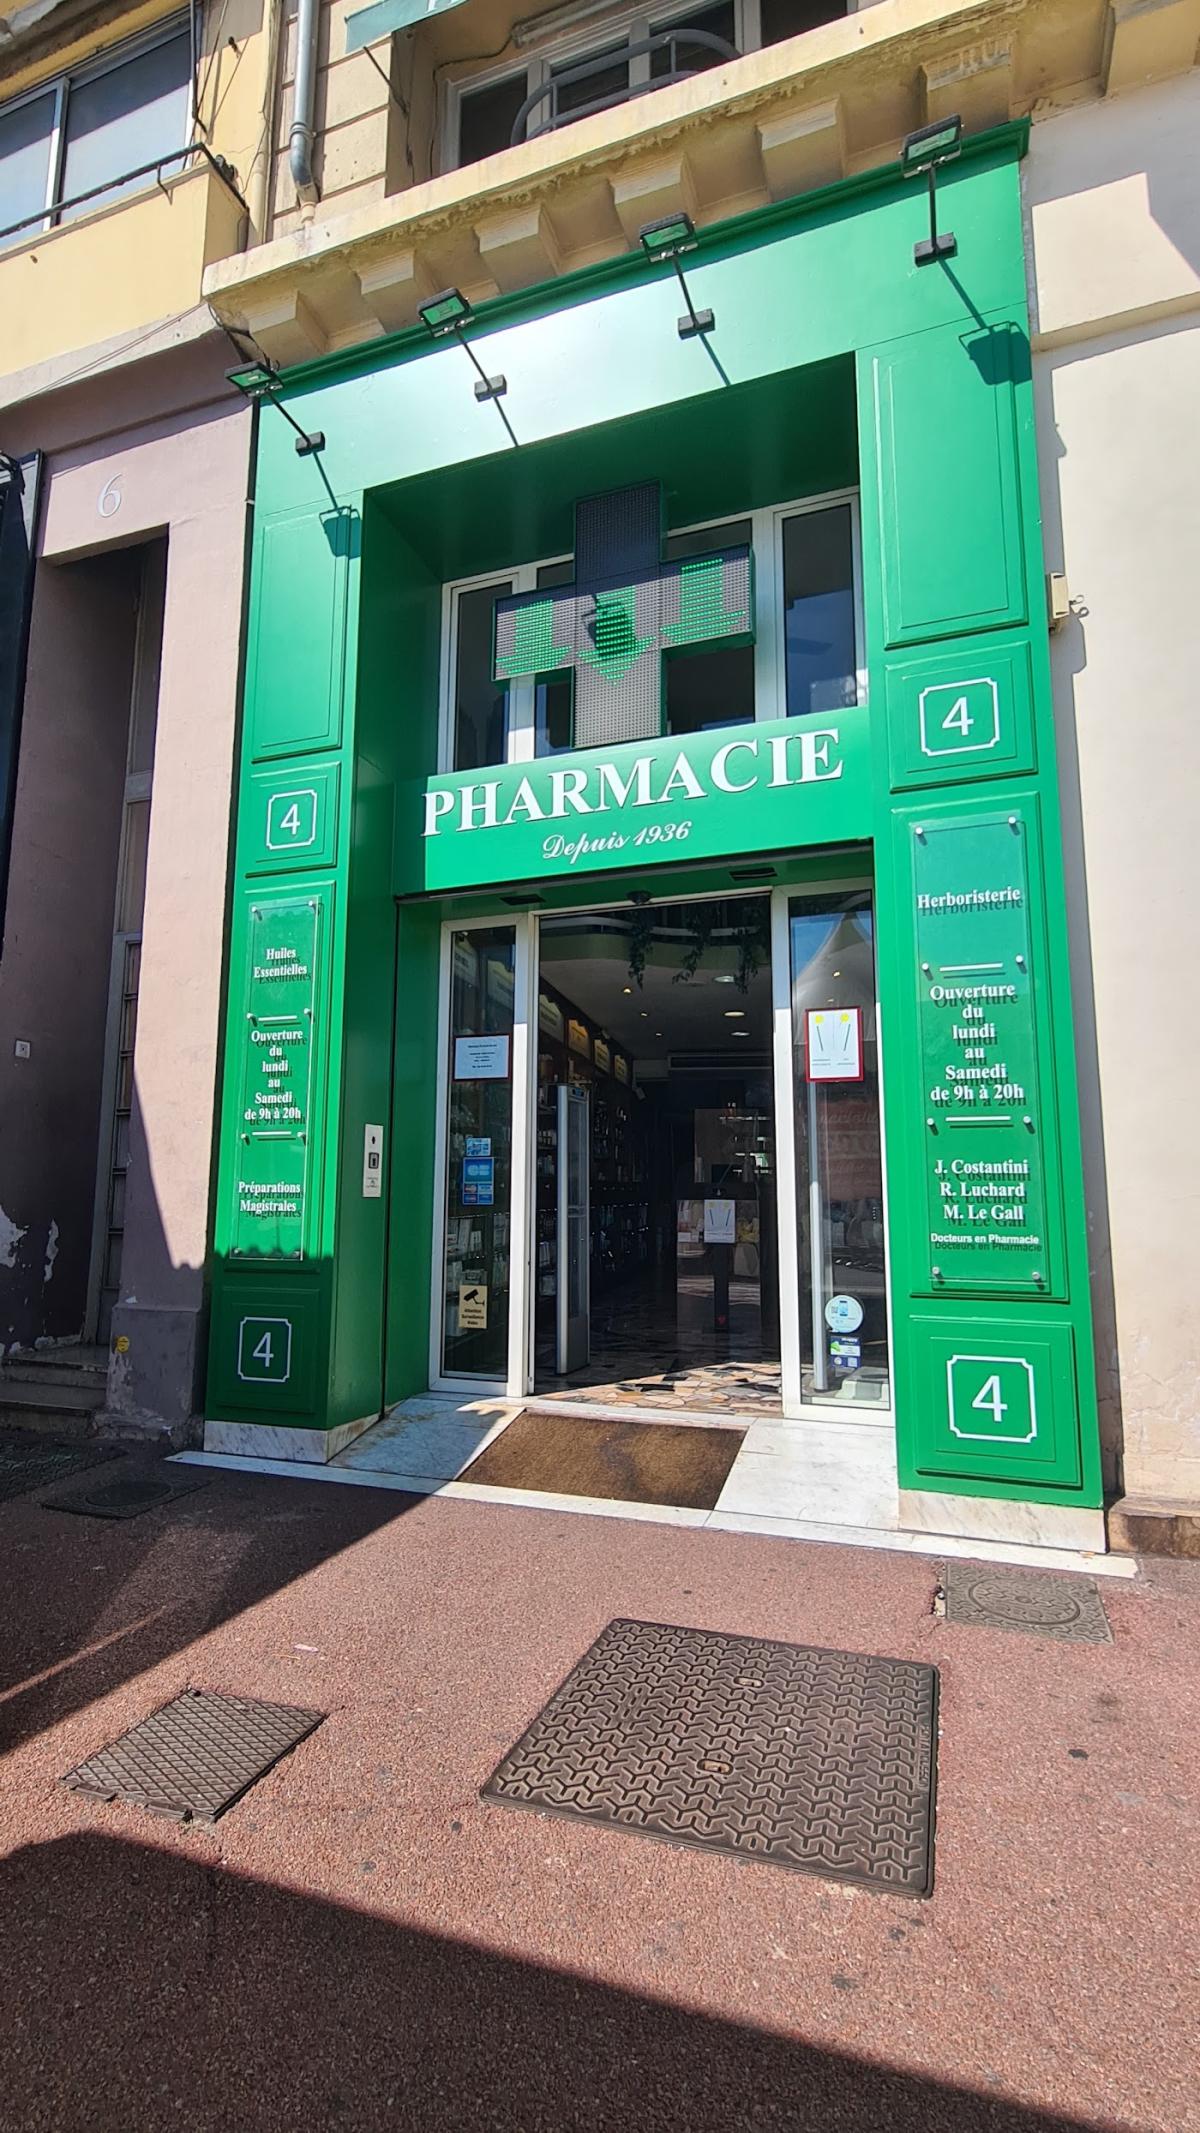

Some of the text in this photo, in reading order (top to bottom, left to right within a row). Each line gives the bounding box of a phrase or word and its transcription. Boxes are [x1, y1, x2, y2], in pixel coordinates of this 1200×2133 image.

[98, 472, 122, 518] 6
[942, 696, 974, 736] 4
[421, 728, 844, 837] PHARMACIE
[280, 803, 301, 835] 4
[542, 820, 693, 865] Depuis 1936
[917, 886, 1021, 909] Herboristerie
[265, 947, 297, 960] Huiles
[253, 963, 308, 978] Essentielles
[929, 984, 1016, 1001] Ouverture
[962, 1004, 984, 1018] du
[251, 1030, 304, 1042] Ouverture
[952, 1023, 996, 1039] lundi
[269, 1044, 283, 1057] du
[964, 1047, 985, 1059] au
[262, 1060, 288, 1073] lundi
[945, 1063, 1007, 1080] Samedi
[267, 1078, 281, 1088] au
[254, 1091, 293, 1104] Samedi
[930, 1083, 1025, 1101] de 9h à 20h
[244, 1107, 301, 1120] de 9h à 20h
[934, 1158, 1028, 1174] J. Costantini
[238, 1181, 301, 1196] Préparations
[940, 1182, 1025, 1197] R. Luchard
[240, 1199, 297, 1215] Magistrales
[943, 1204, 1024, 1220] M. Le Gall
[931, 1232, 1040, 1245] Docteurs en Pharmacie
[253, 1332, 274, 1367] 4
[972, 1375, 1008, 1422] 4
